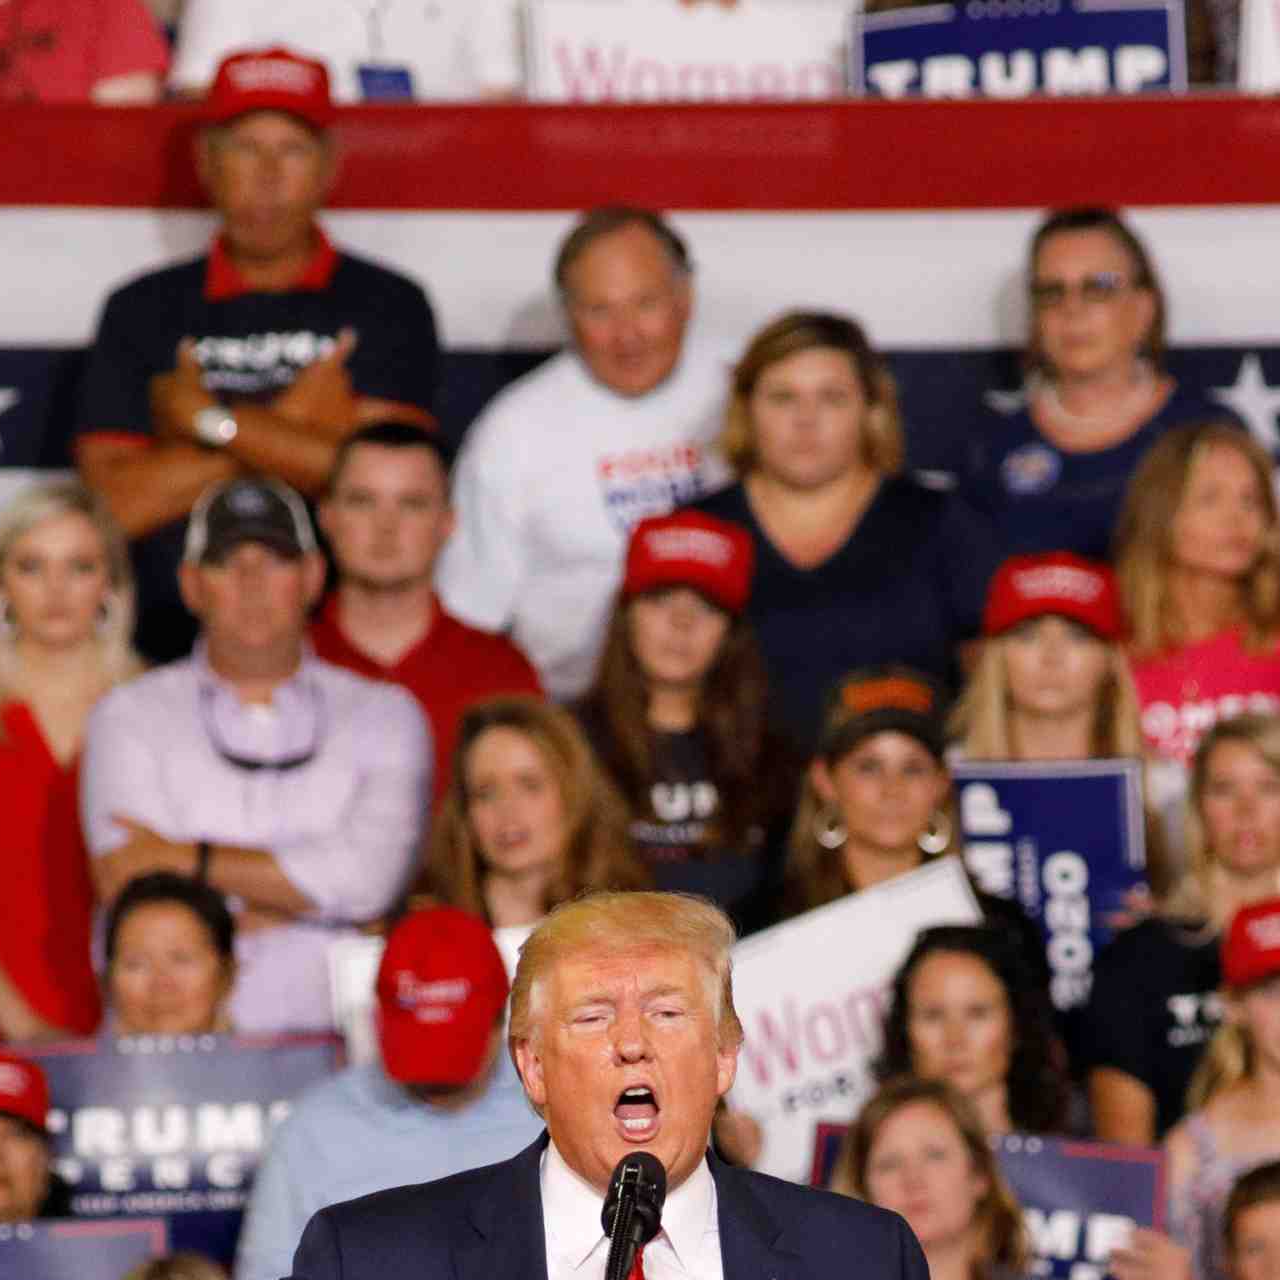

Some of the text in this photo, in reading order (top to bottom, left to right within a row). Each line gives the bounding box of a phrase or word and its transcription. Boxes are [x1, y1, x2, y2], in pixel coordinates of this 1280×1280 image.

[867, 44, 1167, 99] TRUMP
[742, 978, 898, 1086] Wom
[46, 1100, 290, 1155] RUM
[57, 1151, 246, 1191] ENC
